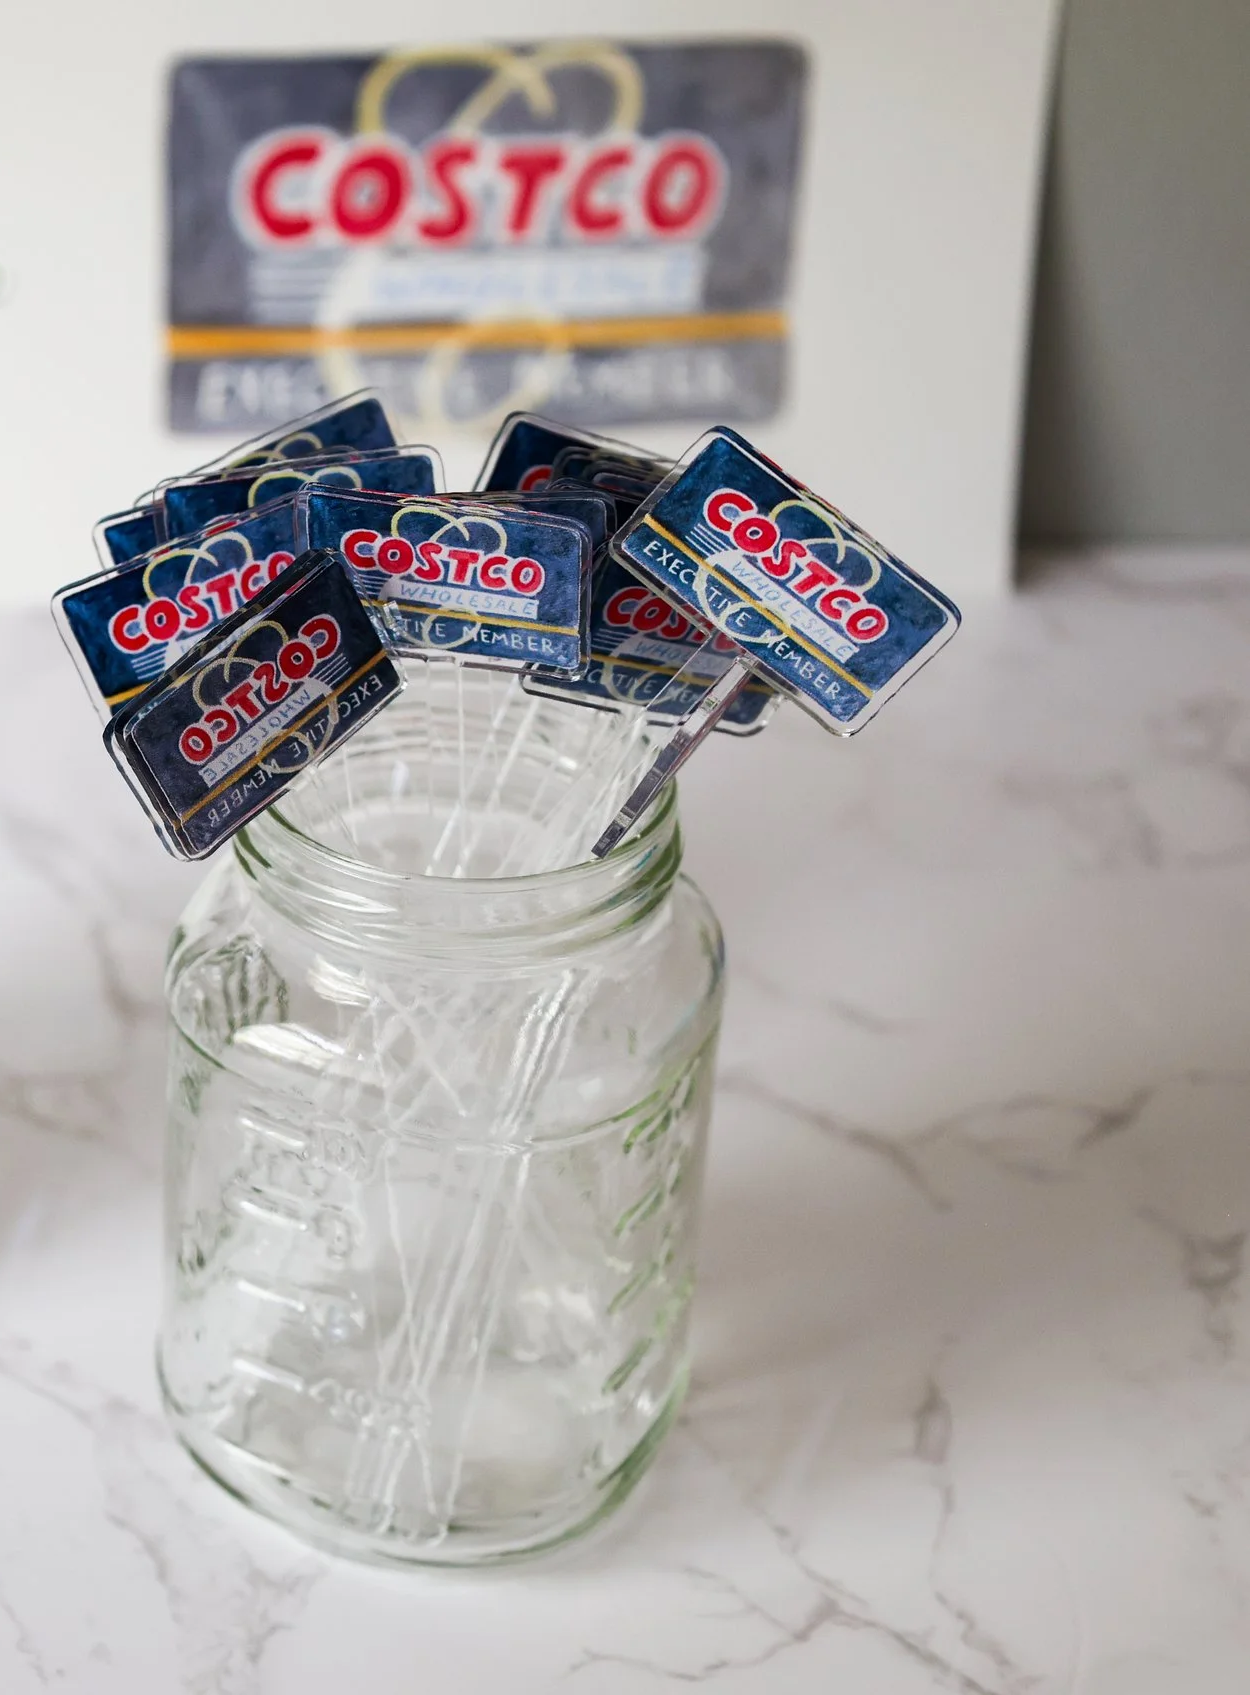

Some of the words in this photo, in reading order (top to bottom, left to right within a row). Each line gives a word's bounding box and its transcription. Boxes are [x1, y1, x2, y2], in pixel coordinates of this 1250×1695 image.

[244, 132, 720, 246] COSTCO
[342, 530, 544, 596] COSTCO
[705, 490, 887, 642] COSTCO
[400, 584, 537, 615] WHOLESALE
[733, 561, 853, 658] WHOLESALE
[463, 626, 554, 654] MEMBER
[760, 629, 841, 699] MEMBER
